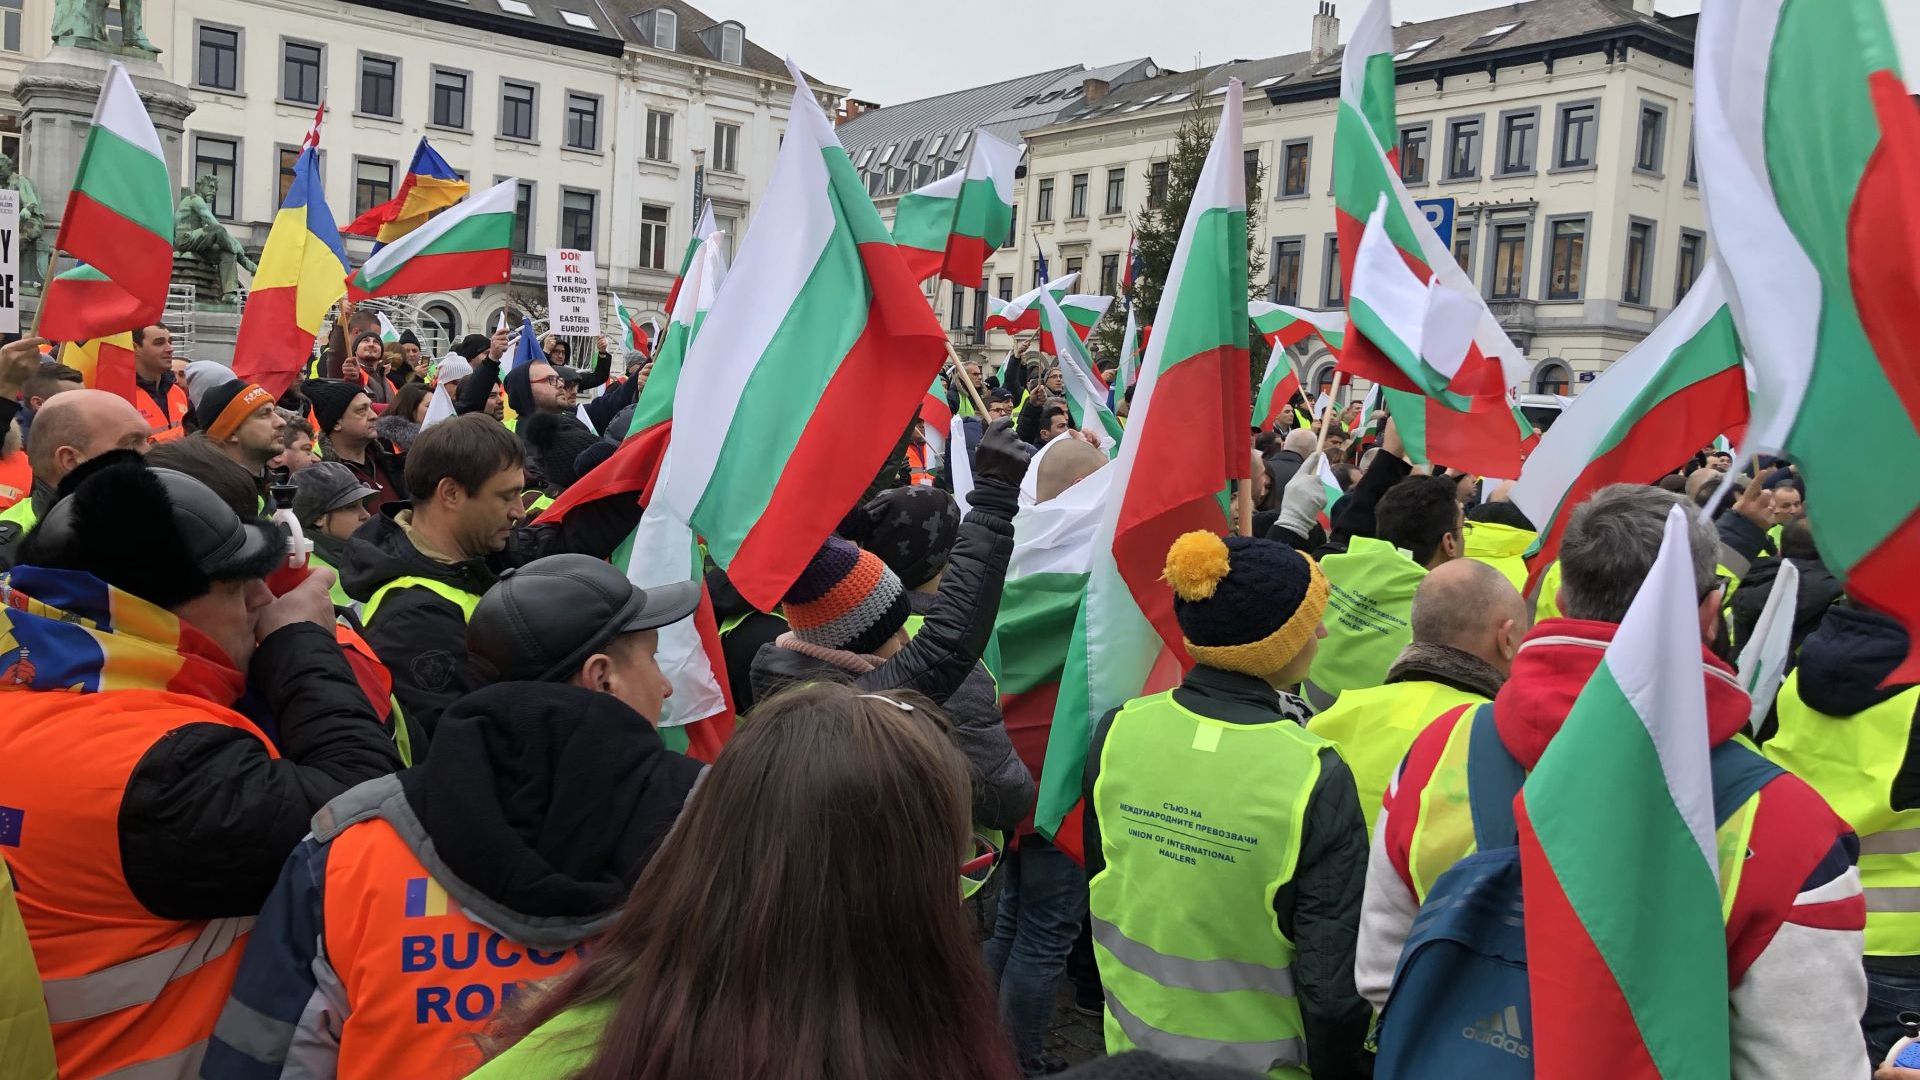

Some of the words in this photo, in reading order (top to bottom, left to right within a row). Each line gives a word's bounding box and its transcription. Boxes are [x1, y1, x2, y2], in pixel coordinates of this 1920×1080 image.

[556, 275, 573, 283] THE
[572, 305, 580, 313] IN
[559, 315, 590, 324] EASTERN
[1162, 802, 1189, 815] СЪЮЗ
[1190, 809, 1203, 819] НА
[1195, 823, 1259, 846] ПРЕВОЗВАЧИ
[1128, 827, 1153, 841] UNION
[1154, 835, 1166, 843] OF
[1167, 838, 1237, 864] INTERNATIONAL
[1158, 847, 1197, 866] HAULERS
[1462, 1026, 1530, 1059] adidas
